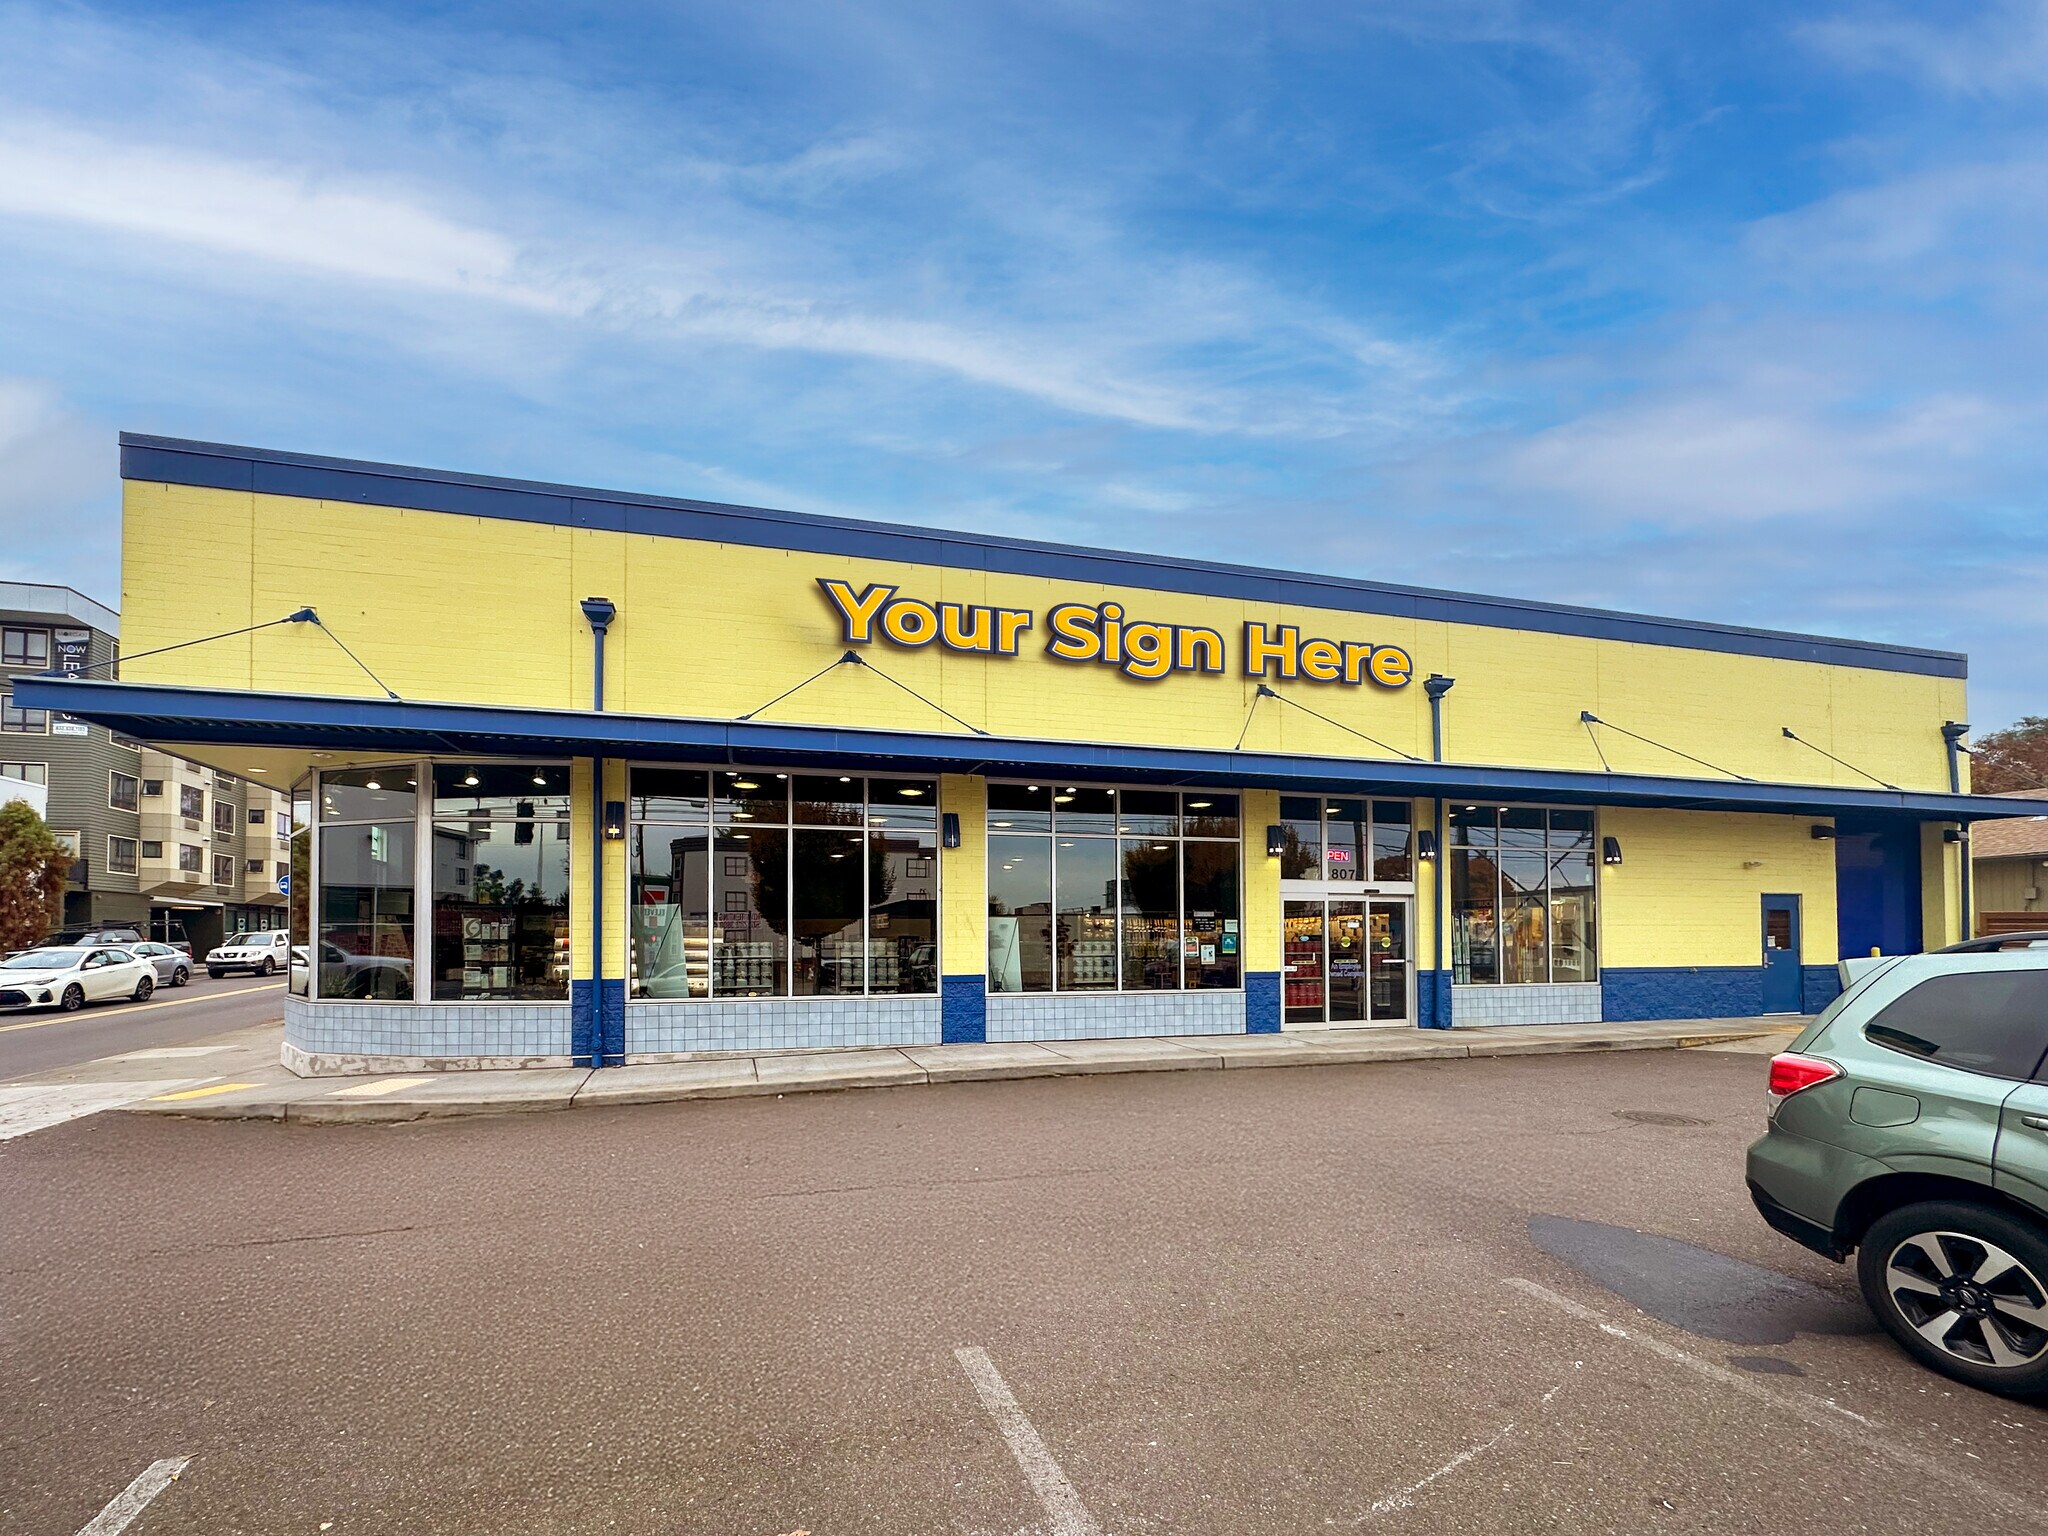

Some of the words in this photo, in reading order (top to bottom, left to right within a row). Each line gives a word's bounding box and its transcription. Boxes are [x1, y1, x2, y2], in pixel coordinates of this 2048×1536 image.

[816, 578, 1033, 656] Your
[1046, 601, 1226, 681] Sign
[1243, 620, 1413, 688] Here
[57, 644, 87, 653] NOW
[1325, 850, 1349, 861] PEN
[1331, 868, 1355, 880] 807
